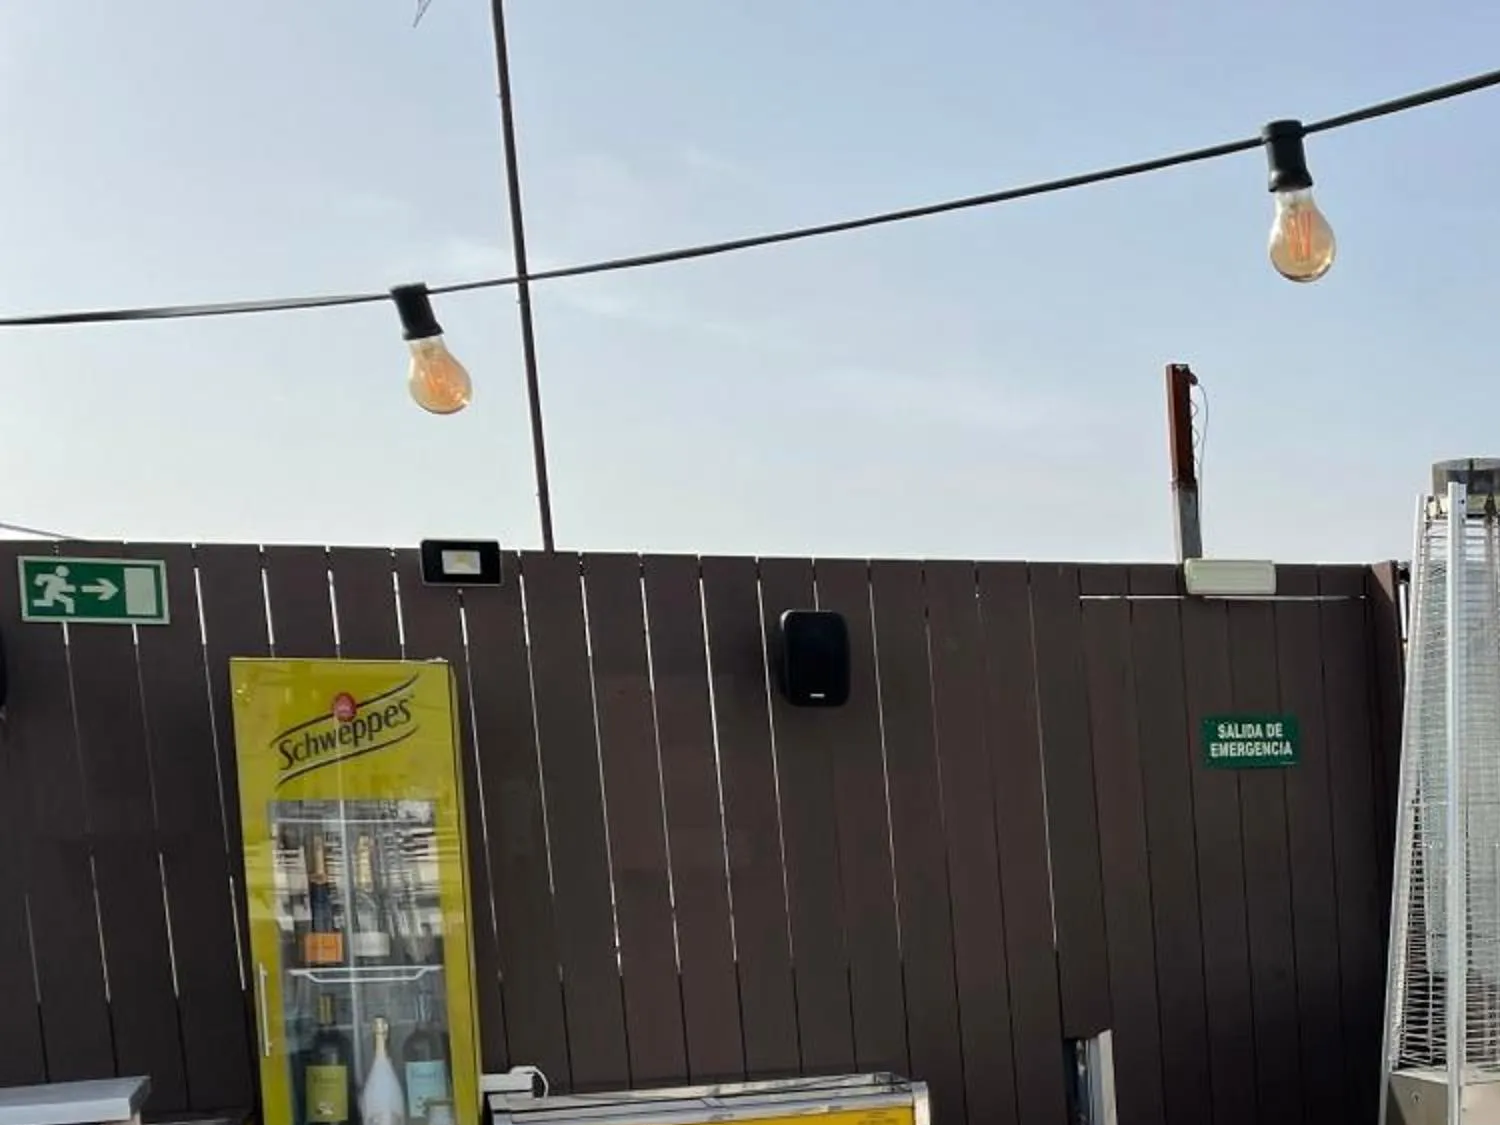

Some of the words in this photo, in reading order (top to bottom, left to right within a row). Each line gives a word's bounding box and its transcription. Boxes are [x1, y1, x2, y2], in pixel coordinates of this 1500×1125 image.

[278, 698, 412, 771] Schweppes
[1217, 722, 1263, 739] SALIDA
[1265, 722, 1284, 739] DE
[1210, 741, 1293, 758] EMERGENCIA
